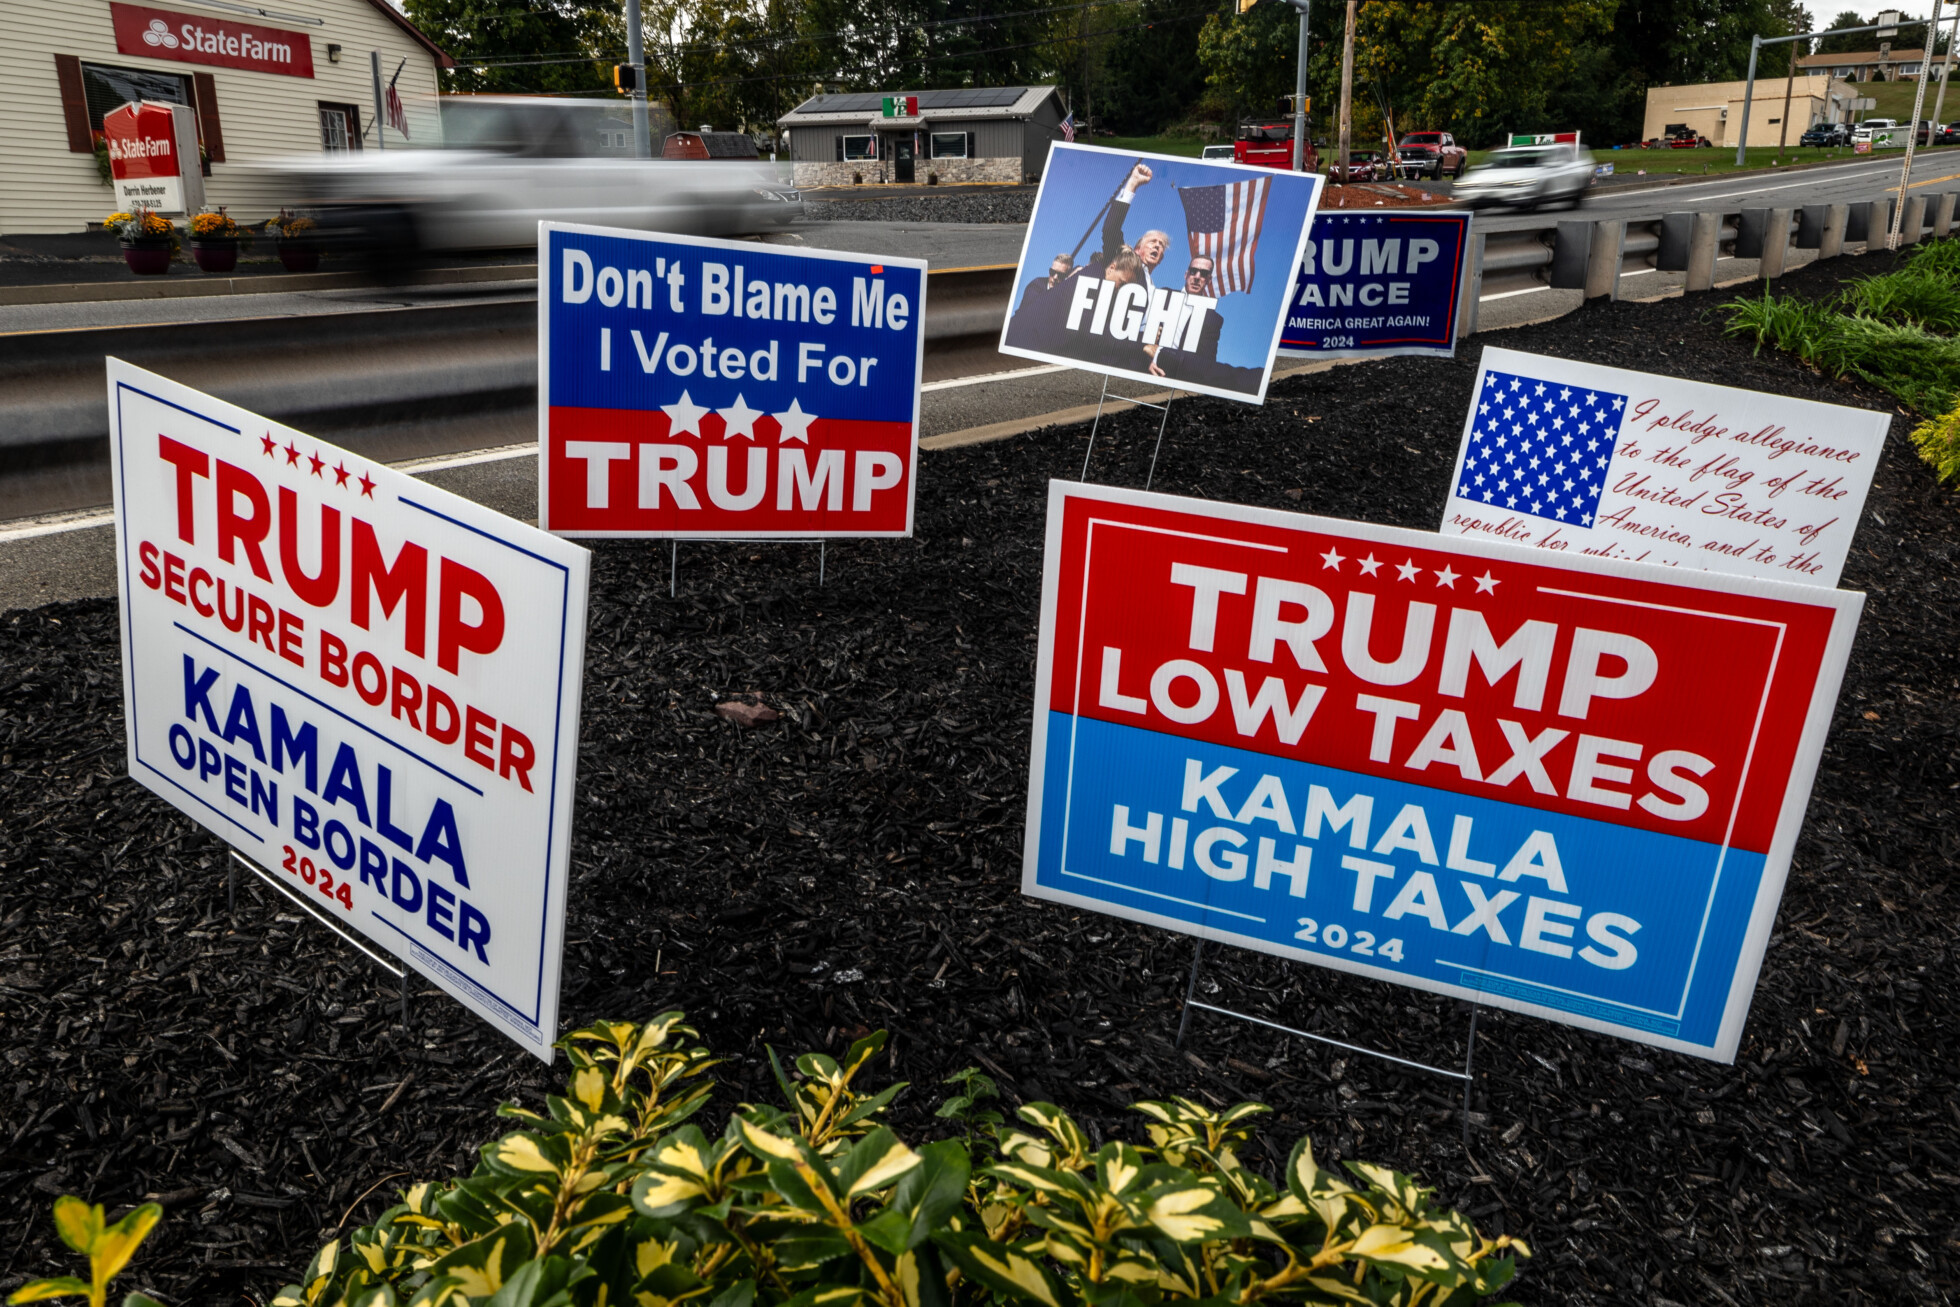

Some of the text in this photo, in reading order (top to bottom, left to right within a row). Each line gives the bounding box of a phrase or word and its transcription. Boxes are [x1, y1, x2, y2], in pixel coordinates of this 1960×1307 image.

[563, 248, 909, 330] Don't Blame Me
[1301, 238, 1440, 276] RUMP
[1066, 275, 1218, 353] FIGHT
[1288, 317, 1342, 330] AMERICA
[1345, 317, 1385, 329] GREAT
[1386, 315, 1430, 327] AGAIN!
[1322, 336, 1354, 348] 2024
[600, 328, 878, 387] I Voted For
[1631, 398, 1860, 464] I pledge allegiance
[565, 440, 903, 512] TRUMP
[1614, 440, 1848, 500] to the flag of the
[1448, 513, 1531, 541] republic
[1598, 506, 1823, 575] America, and to the
[1613, 472, 1839, 546] United States of
[158, 433, 505, 677] TRUMP
[138, 541, 536, 794] SECURE BORDER
[1170, 561, 1659, 721] TRUMP
[1098, 646, 1716, 822] LOW TAXES
[183, 653, 471, 891] KAMALA
[169, 723, 491, 967] OPEN BORDER
[1181, 758, 1569, 894] KAMALA
[282, 845, 353, 911] 2024
[1108, 804, 1642, 971] HIGH TAXES
[1294, 917, 1406, 962] 2024
